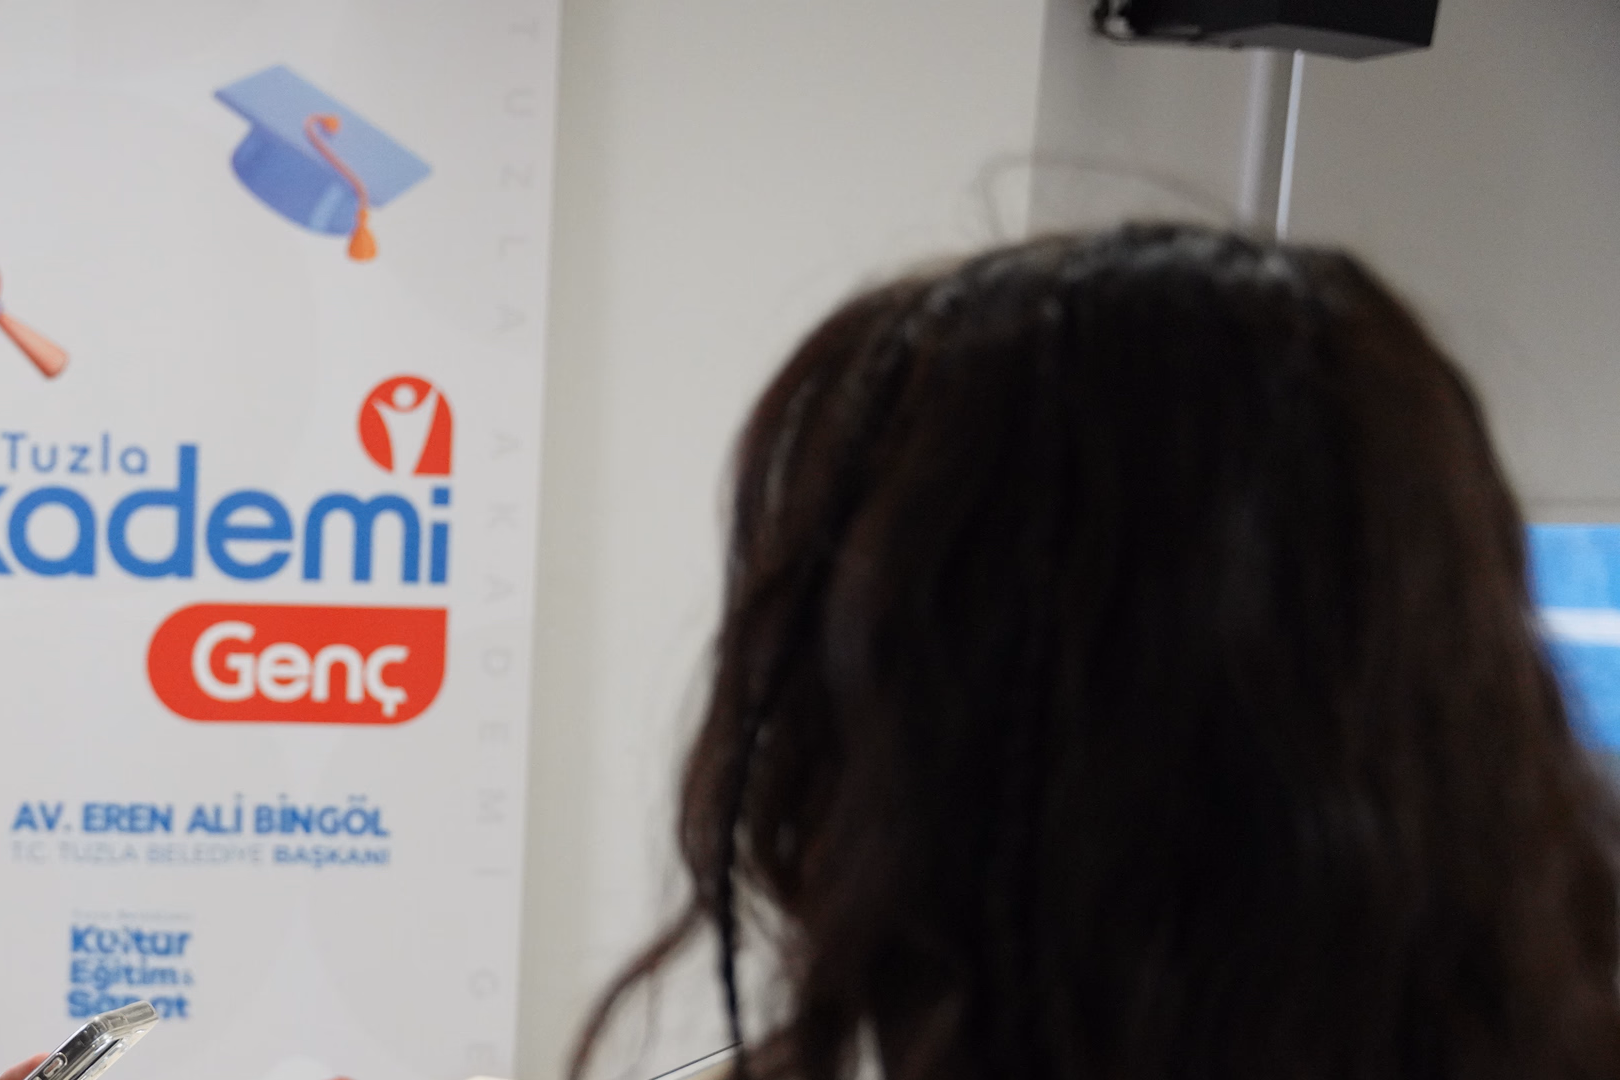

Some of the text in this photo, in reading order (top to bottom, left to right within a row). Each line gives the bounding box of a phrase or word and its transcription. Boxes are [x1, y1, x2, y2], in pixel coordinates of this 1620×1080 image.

[1, 431, 149, 477] Tuzla
[191, 620, 410, 717] Genç
[10, 802, 72, 833] AV.
[82, 803, 173, 833] EREN
[187, 795, 244, 834] ALİ
[253, 795, 391, 838] BİNGÖL
[58, 843, 138, 865] TUZLA
